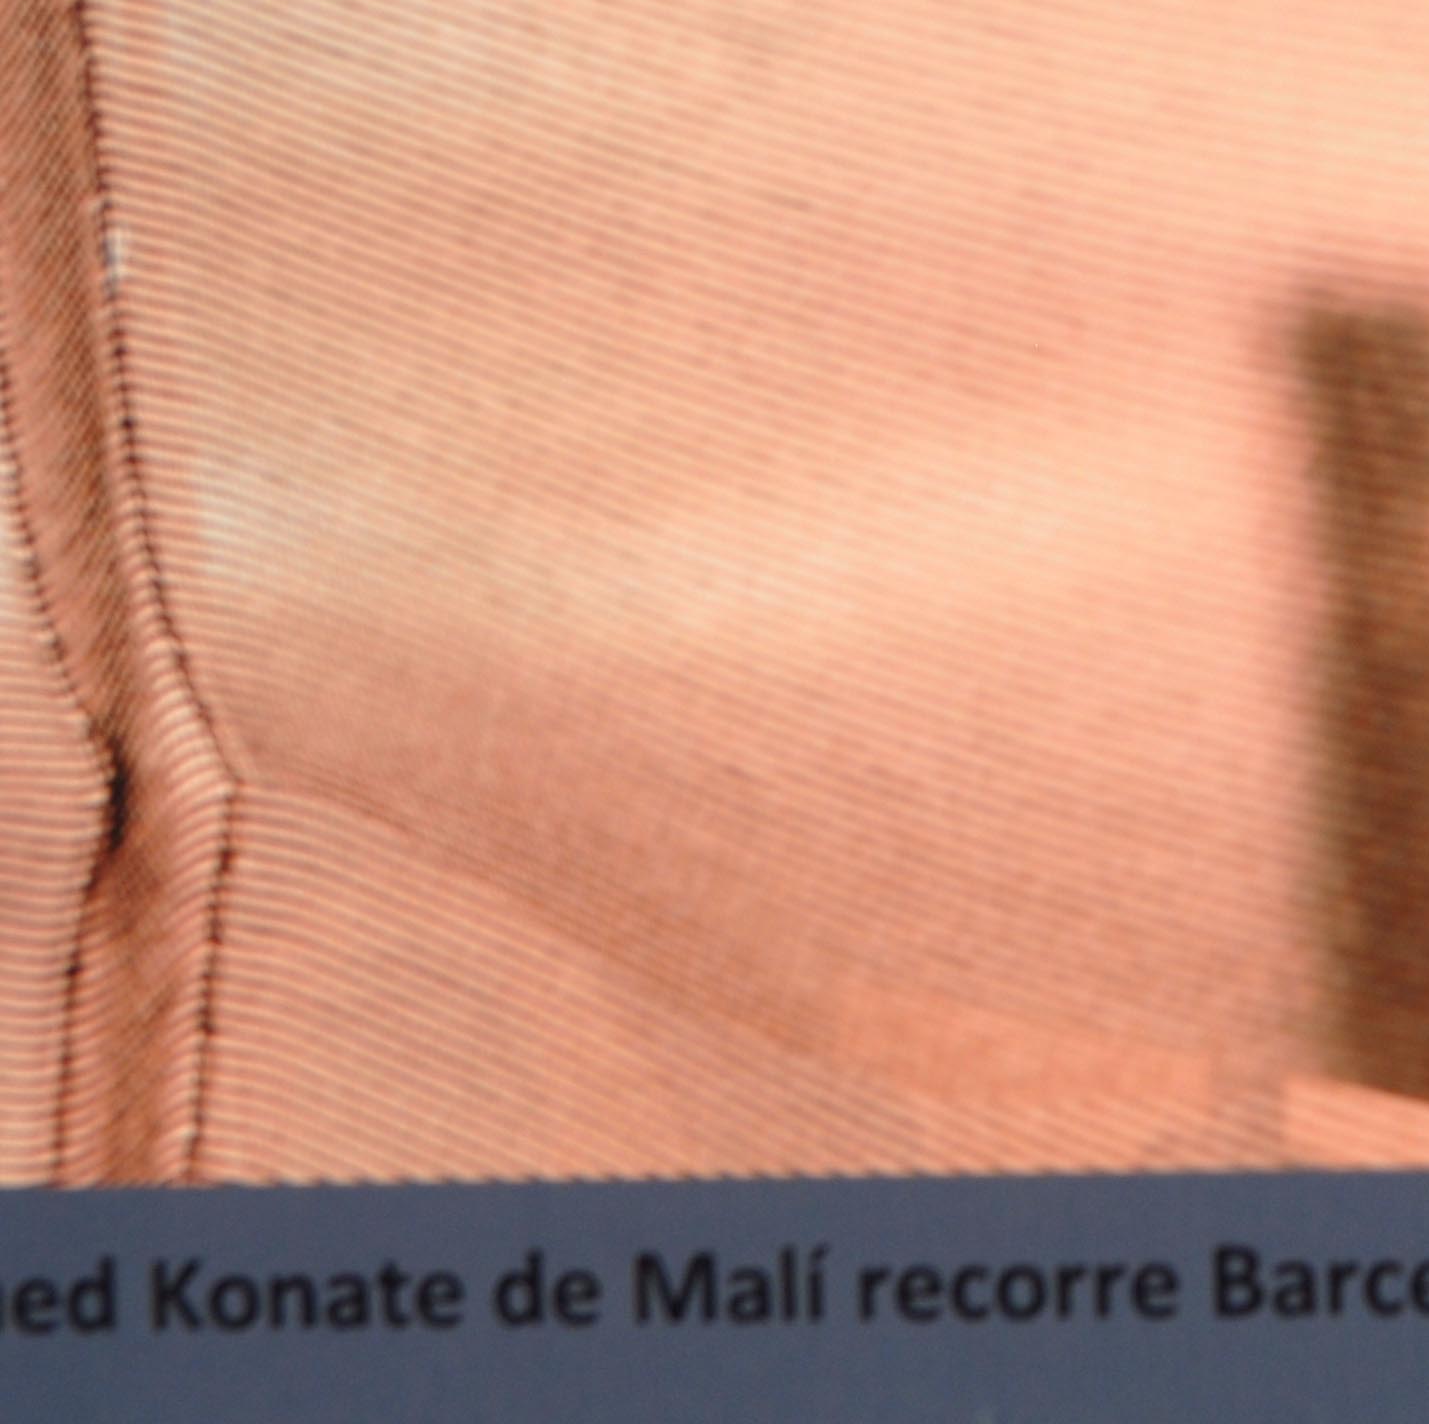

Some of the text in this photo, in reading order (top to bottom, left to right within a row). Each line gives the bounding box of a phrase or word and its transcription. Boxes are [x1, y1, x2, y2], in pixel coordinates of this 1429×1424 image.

[0, 1257, 118, 1334] ed
[150, 1258, 466, 1333] Konate
[491, 1248, 602, 1327] de
[632, 1242, 832, 1325] Malí
[856, 1252, 1181, 1322] recorre
